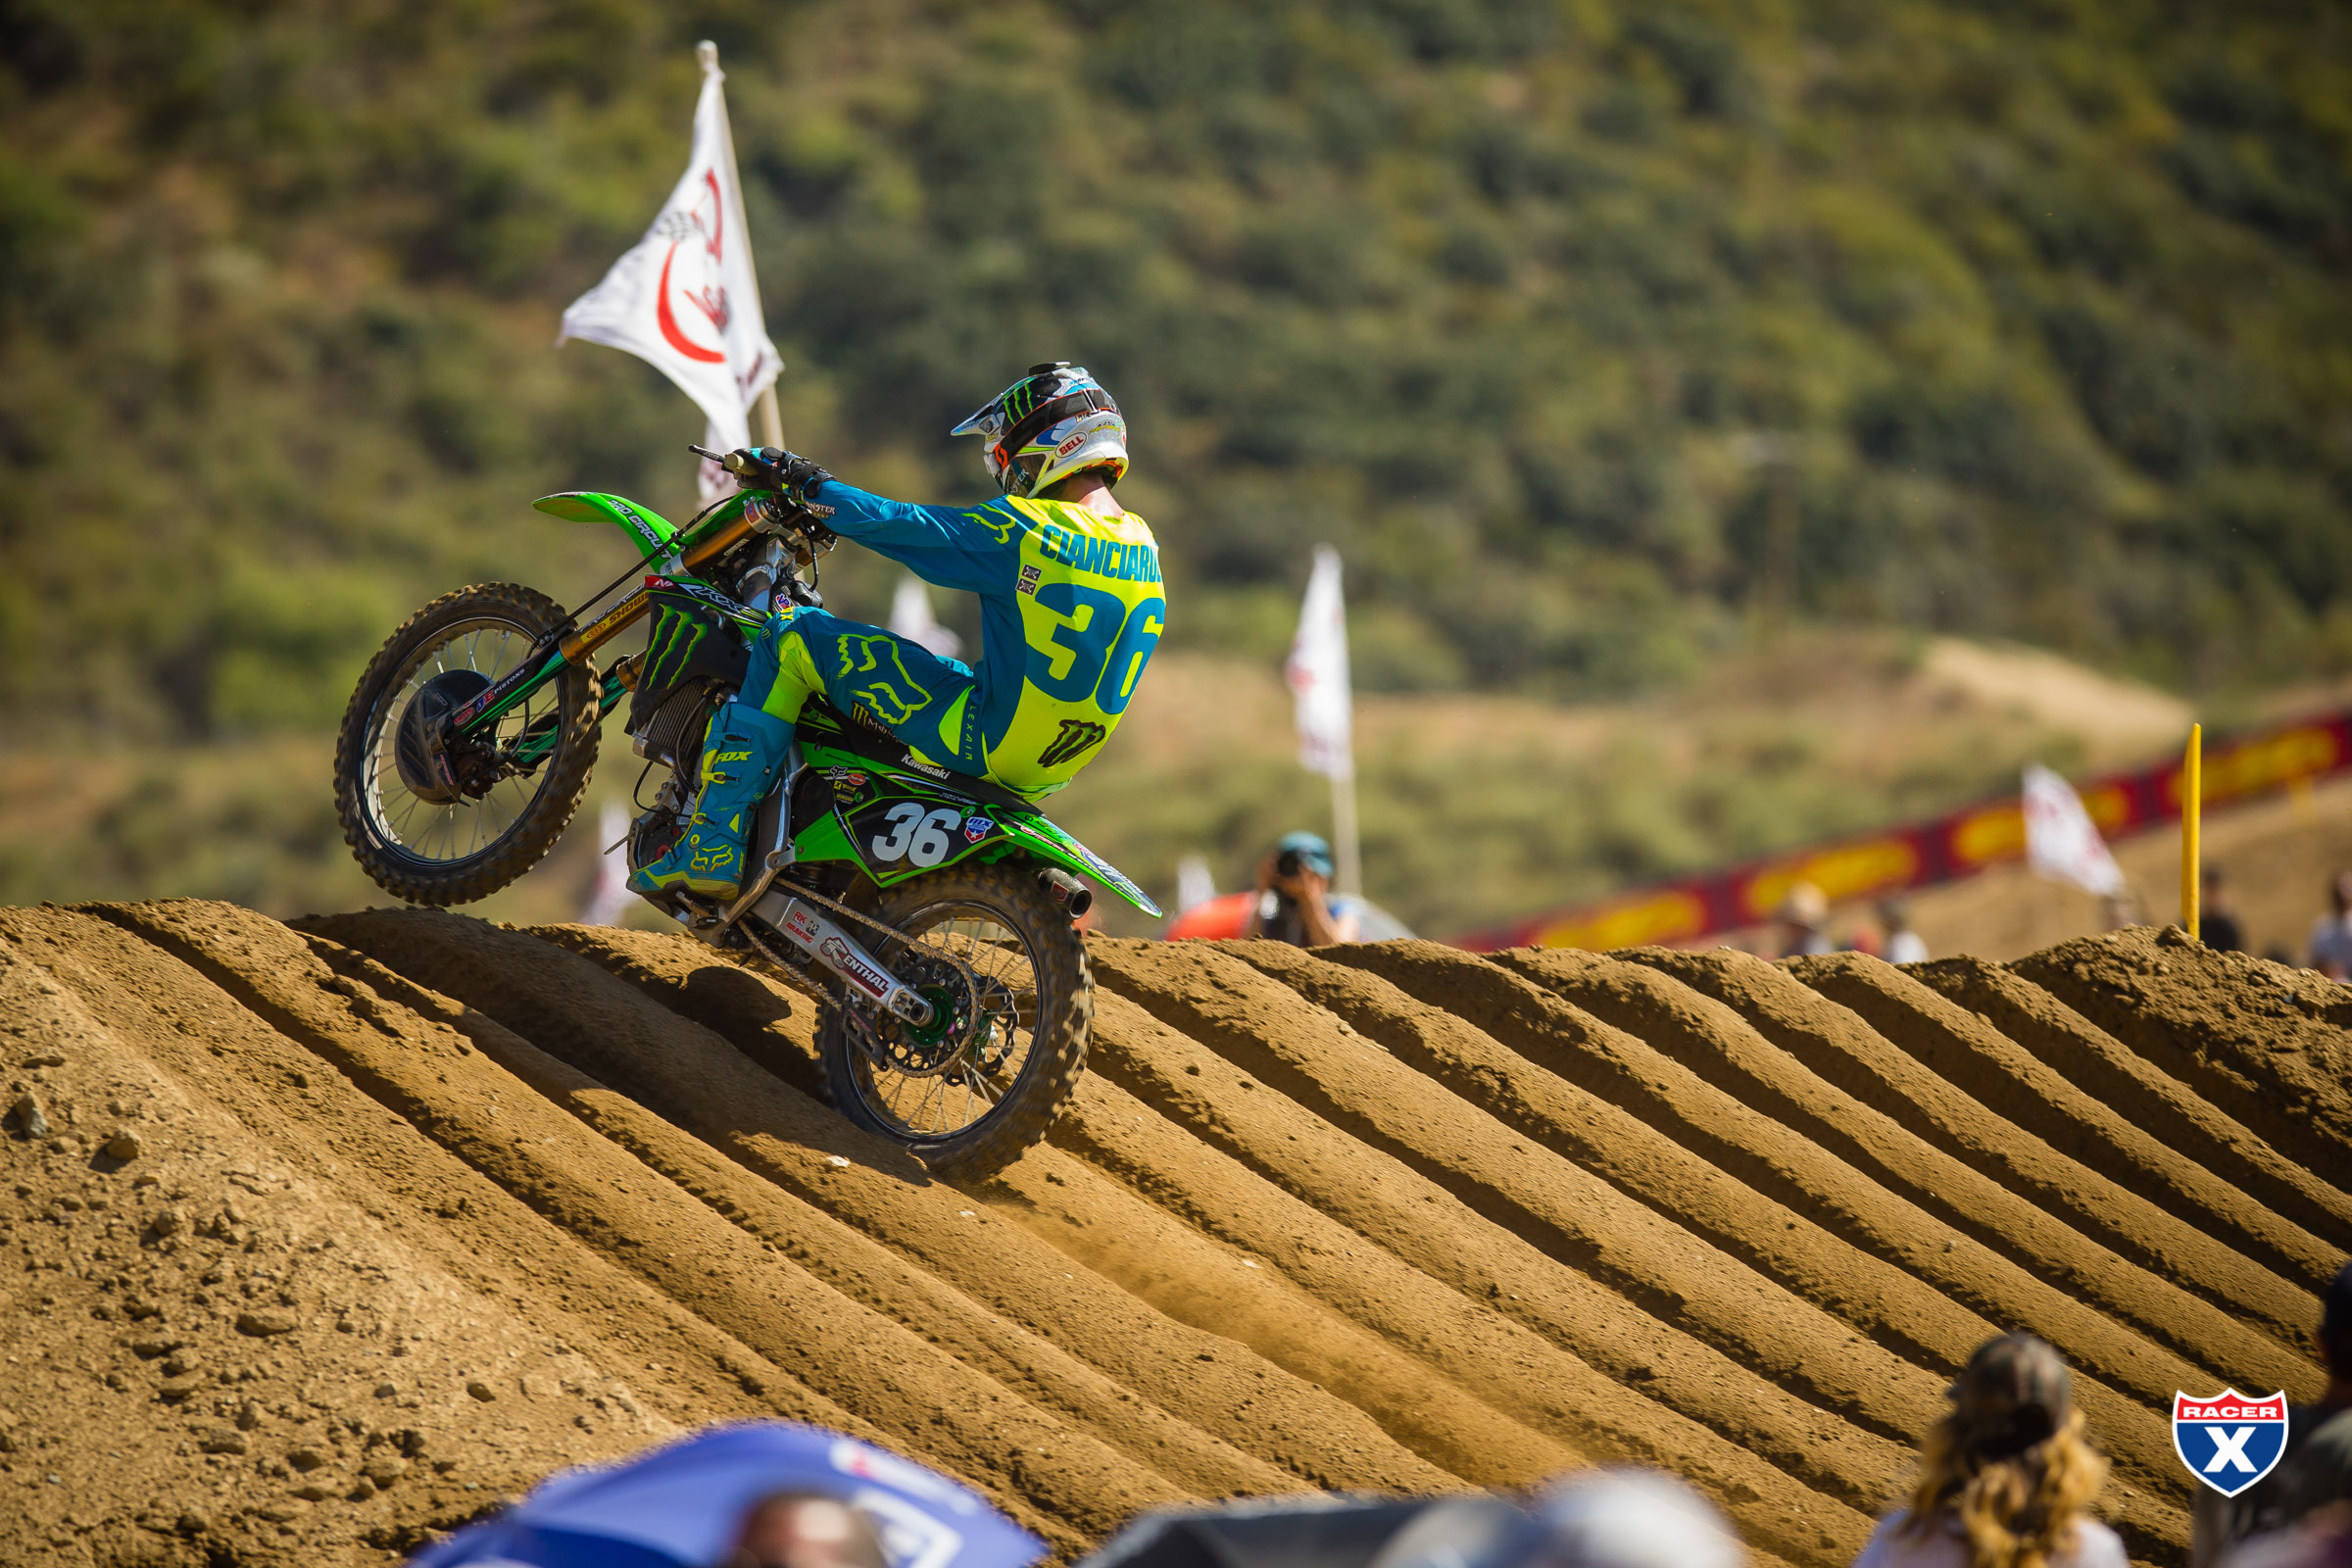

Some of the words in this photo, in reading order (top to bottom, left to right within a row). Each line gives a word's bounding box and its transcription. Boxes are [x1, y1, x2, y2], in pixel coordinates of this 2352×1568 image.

[1058, 436, 1084, 457] BELL
[1026, 582, 1167, 715] 36
[494, 668, 525, 694] PISTONS
[714, 751, 754, 764] FOX
[901, 754, 951, 780] Kawasaki
[872, 802, 962, 868] 36
[793, 910, 808, 922] RK
[786, 922, 814, 944] BRAKING
